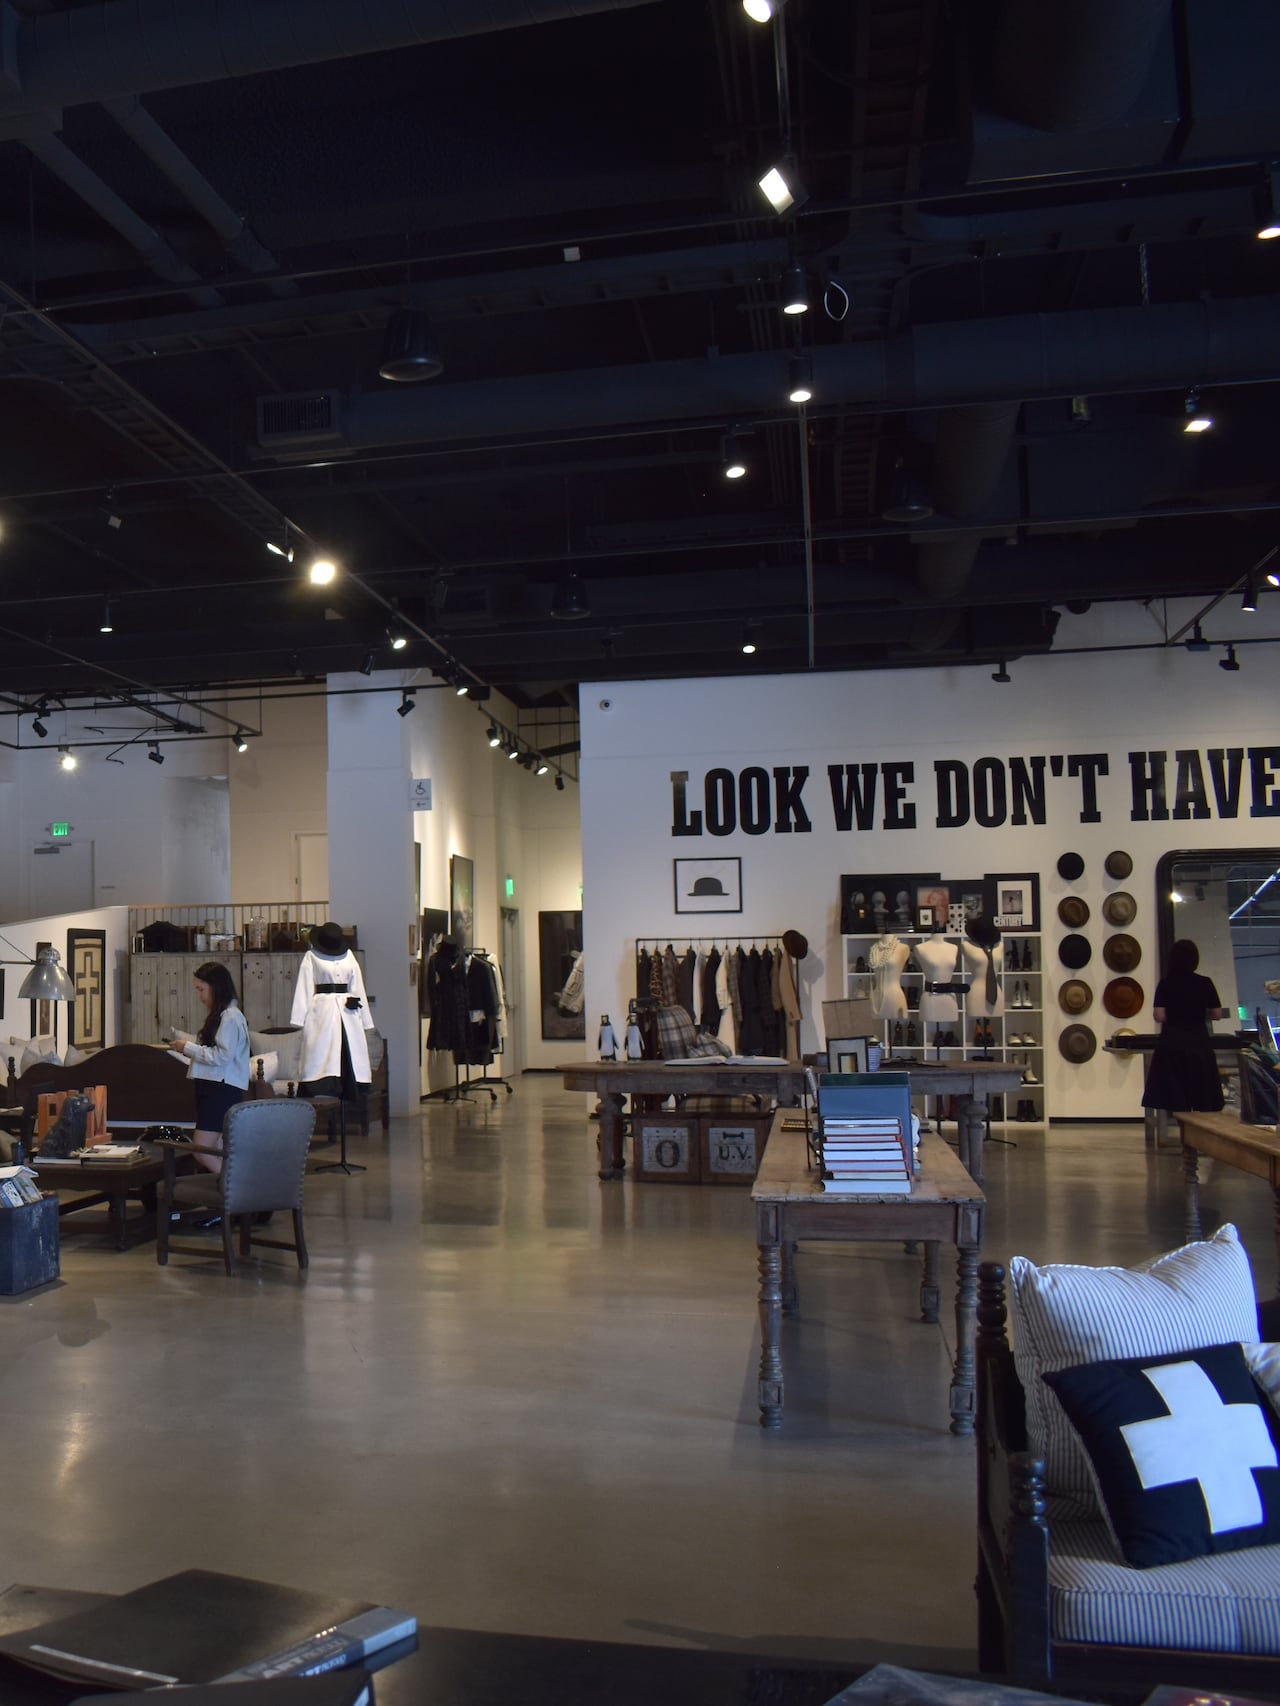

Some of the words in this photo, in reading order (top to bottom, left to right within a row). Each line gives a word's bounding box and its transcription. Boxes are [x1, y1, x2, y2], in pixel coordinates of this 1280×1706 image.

[670, 766, 812, 837] LOOK
[827, 762, 917, 832] WE
[933, 753, 1109, 828] DON'T
[1128, 747, 1280, 821] HAVE
[719, 1145, 752, 1161] U.V.
